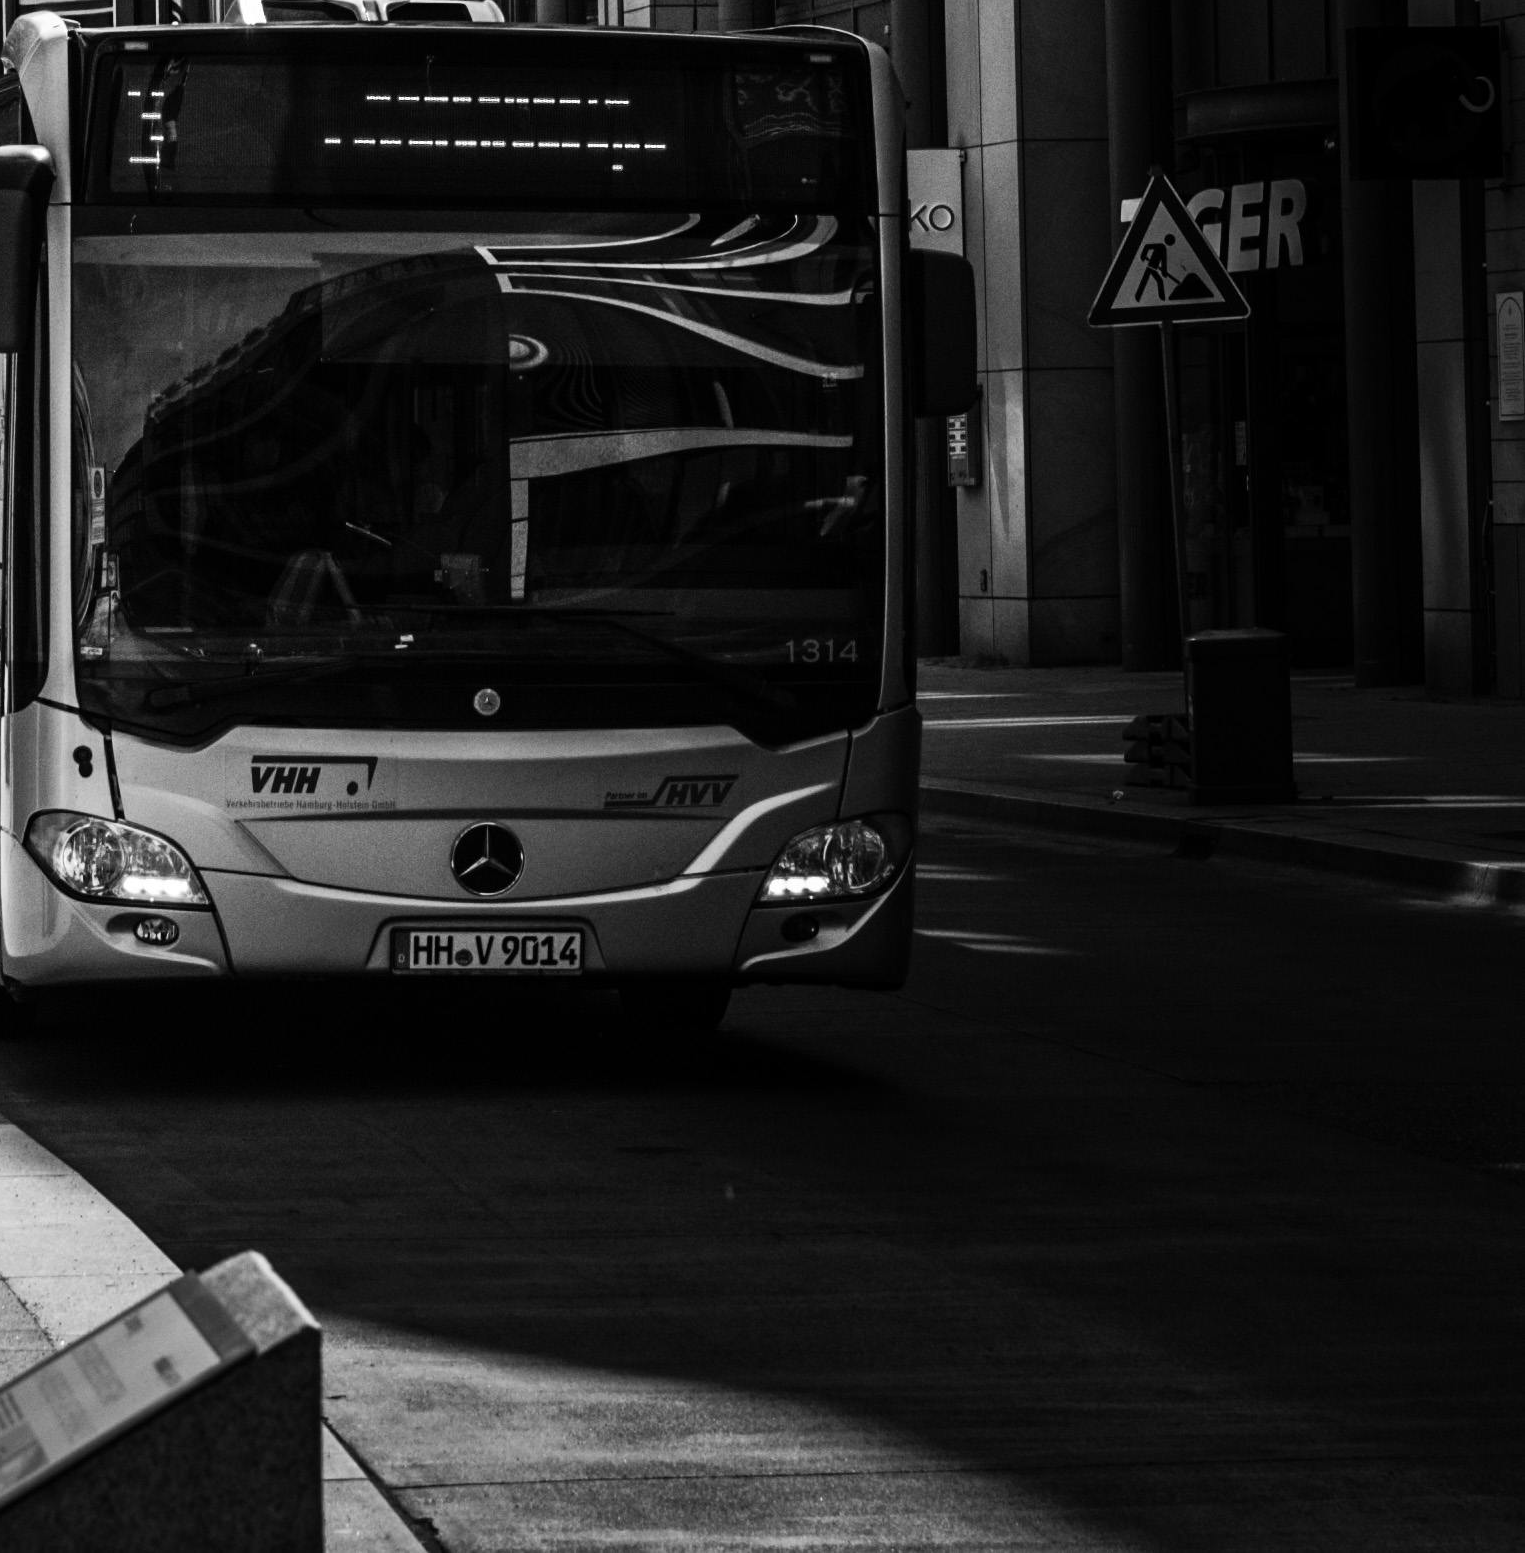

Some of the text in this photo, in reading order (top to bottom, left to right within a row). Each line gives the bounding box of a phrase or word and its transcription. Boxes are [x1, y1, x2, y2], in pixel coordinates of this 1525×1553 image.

[785, 638, 859, 663] 1314
[250, 767, 321, 794] VHH
[666, 781, 735, 805] HVV
[413, 935, 453, 966] HH
[502, 936, 578, 966] 9014
